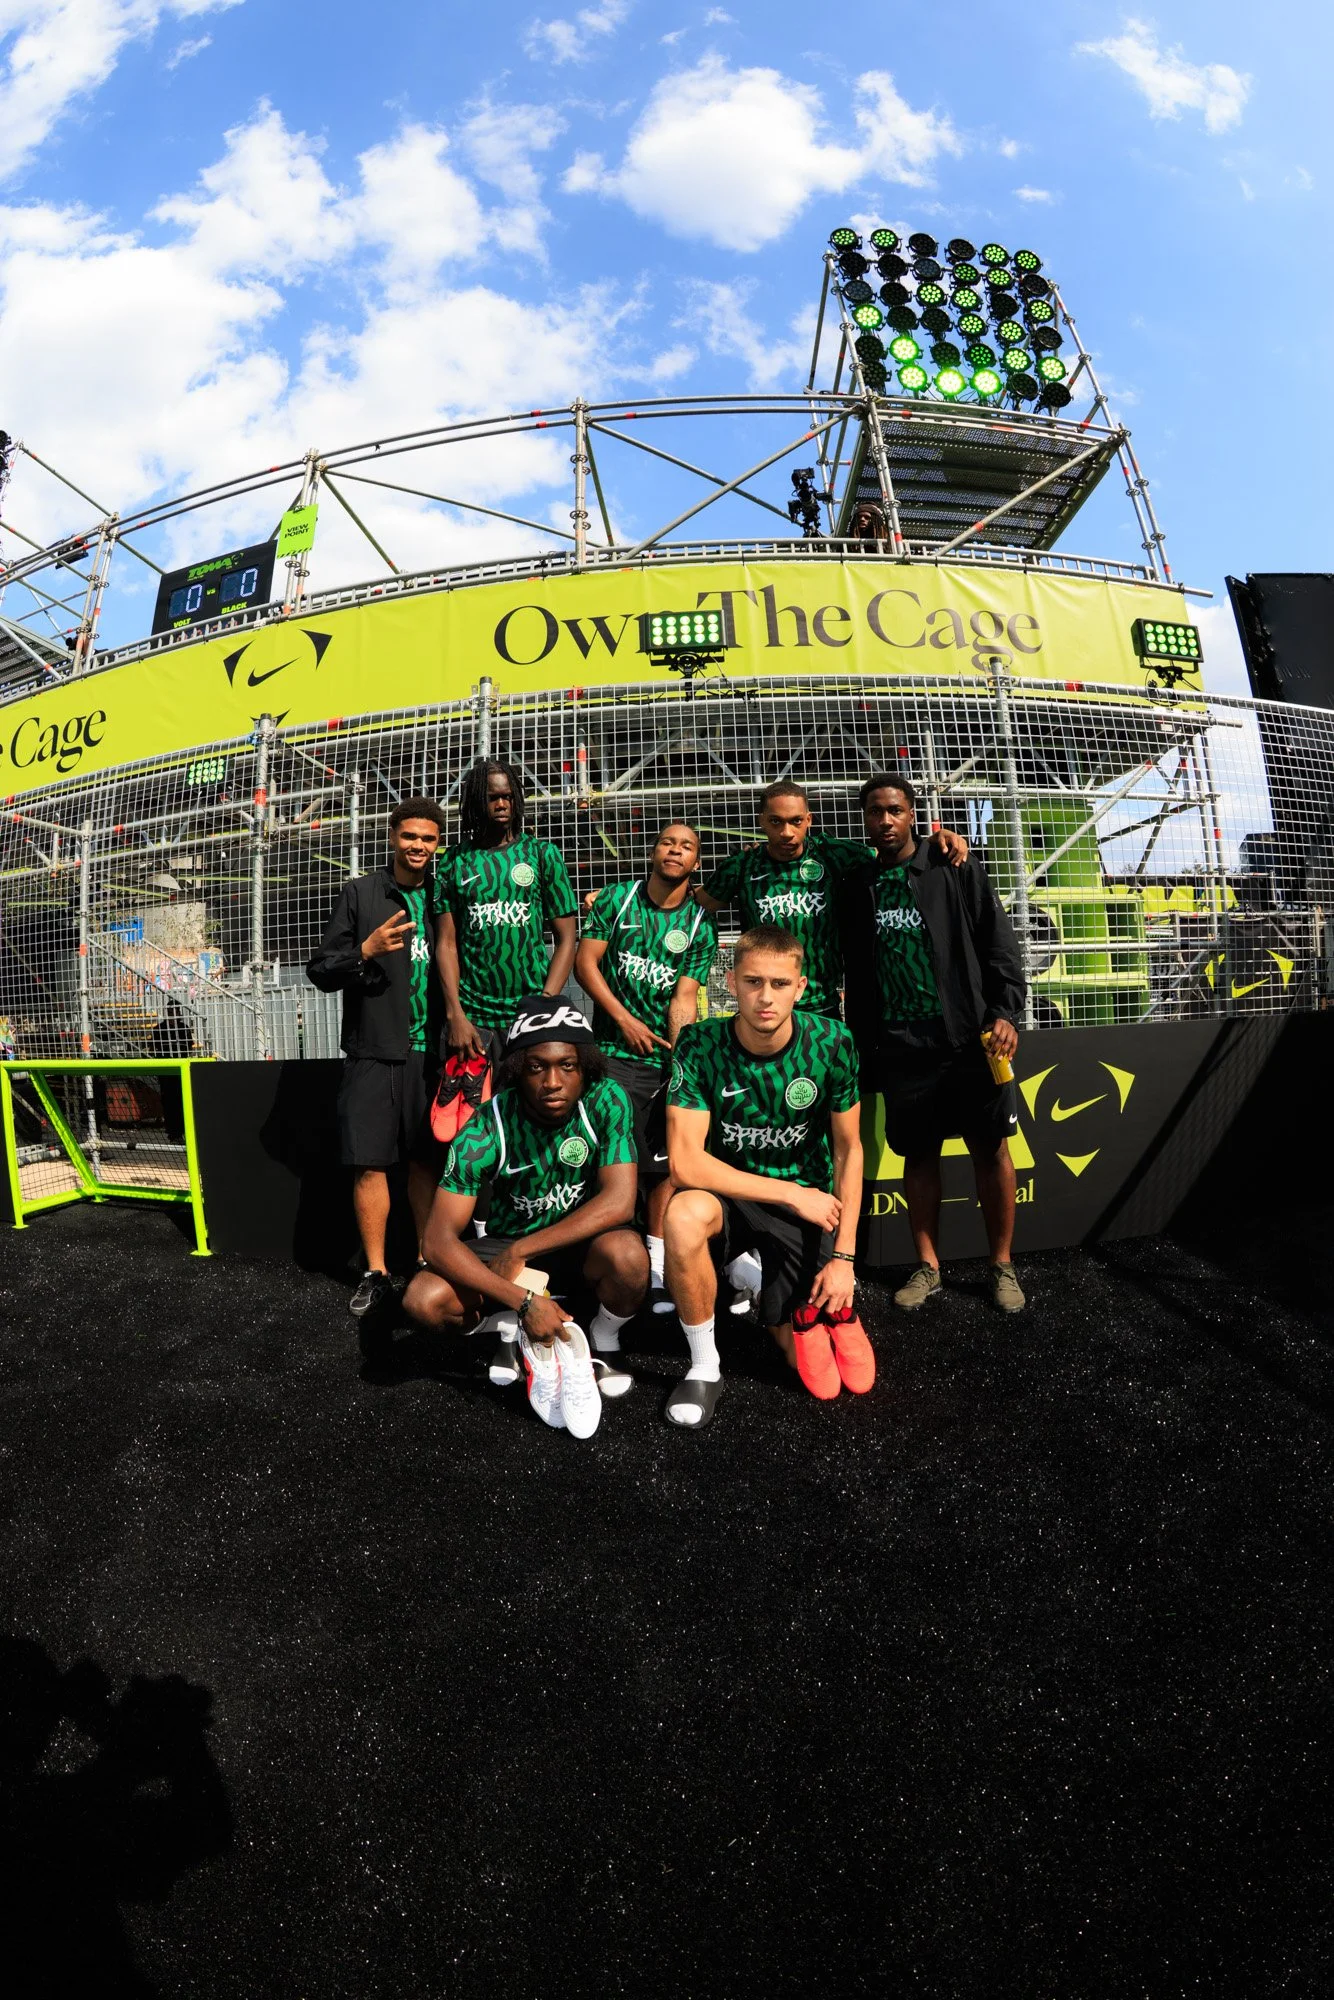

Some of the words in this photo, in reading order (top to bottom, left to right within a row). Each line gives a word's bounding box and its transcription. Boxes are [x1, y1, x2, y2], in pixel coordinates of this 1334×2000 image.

[284, 528, 310, 538] POINT
[287, 523, 308, 532] VIEW
[186, 584, 203, 613] 0
[240, 568, 258, 597] 0
[221, 602, 247, 614] BLACK
[173, 618, 191, 628] VOLT
[695, 584, 853, 648] The
[867, 589, 1043, 672] Cage
[10, 710, 106, 773] Cage
[875, 906, 926, 935] PRUC
[506, 1006, 594, 1046] ick
[861, 1192, 909, 1216] DN
